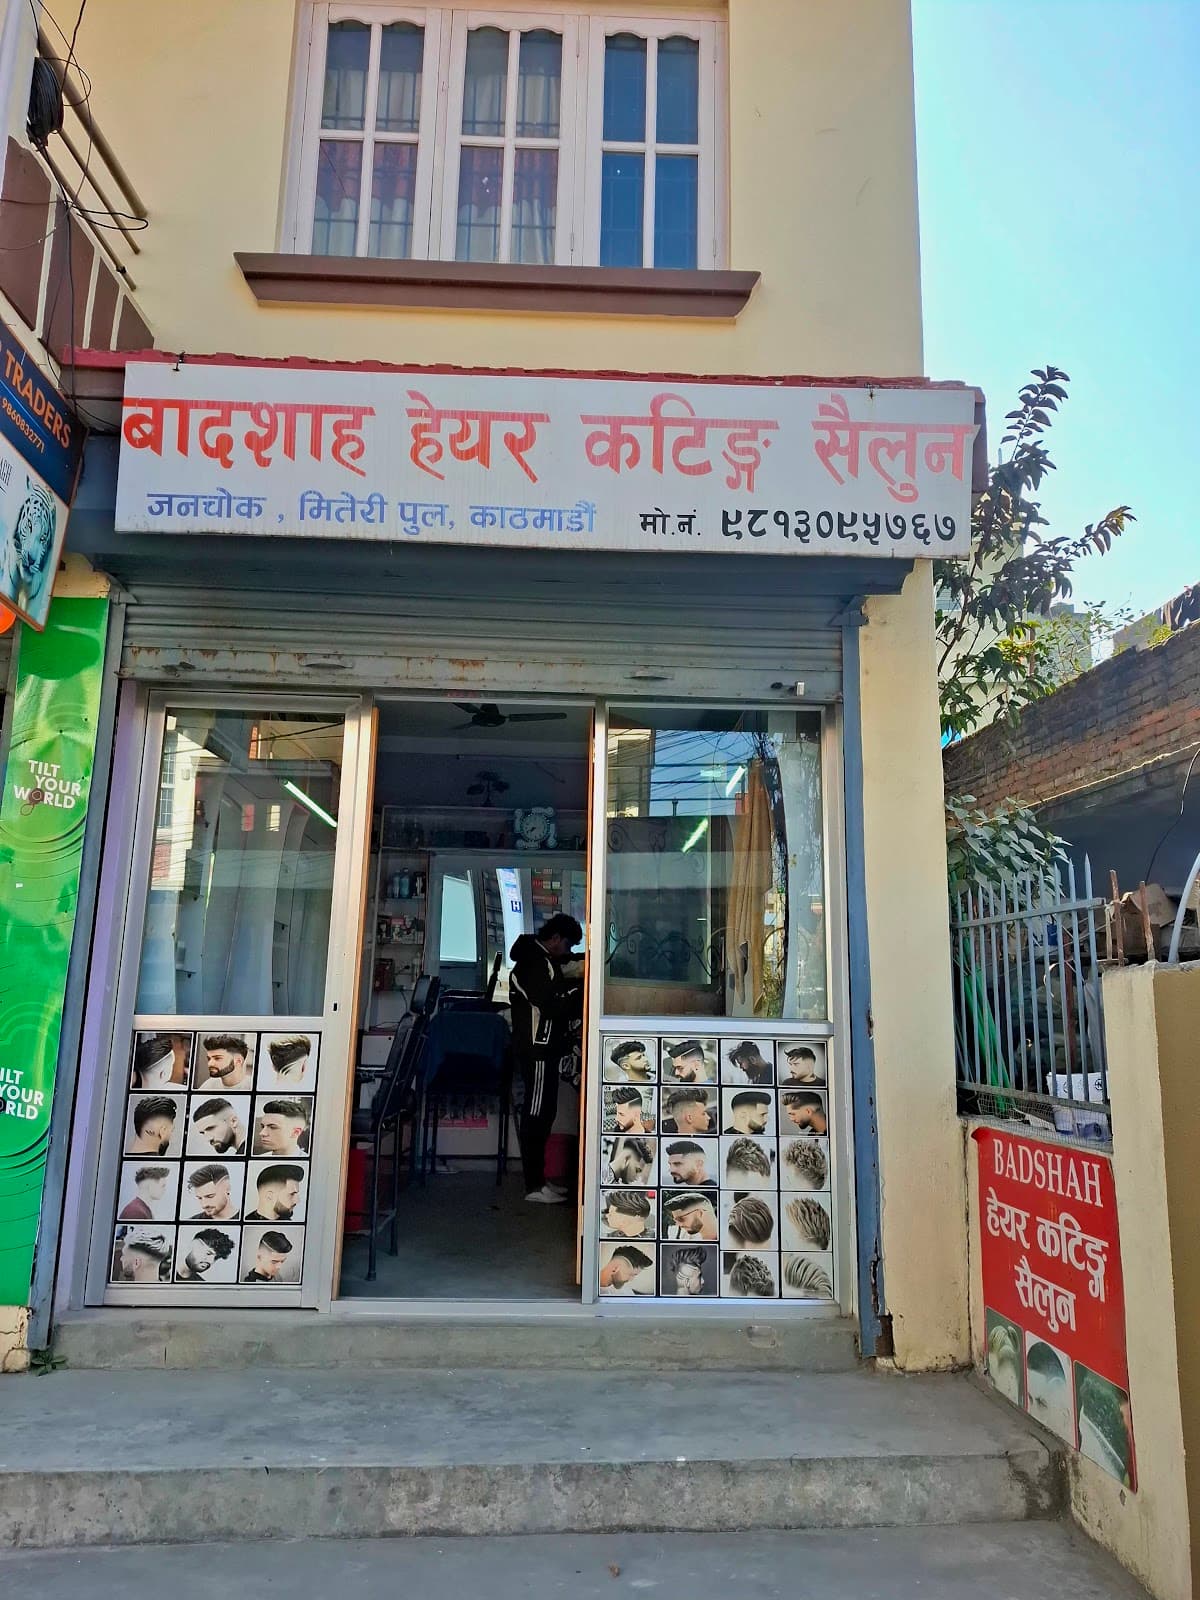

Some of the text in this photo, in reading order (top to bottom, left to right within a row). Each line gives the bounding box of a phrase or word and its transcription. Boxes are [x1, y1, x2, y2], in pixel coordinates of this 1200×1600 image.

[2, 397, 45, 453] 9860832771
[5, 348, 71, 449] TRADERS
[123, 397, 376, 477] बादशाह
[405, 389, 550, 484] हेयर
[811, 392, 981, 504] सैलुन
[299, 489, 388, 524] मितेरी
[721, 509, 956, 546] ९८१३०९५७६७
[13, 784, 76, 809] WORLD
[28, 759, 61, 778] TILT
[35, 775, 82, 797] YOUR
[993, 1138, 1103, 1208] BADSHAH
[986, 1186, 1031, 1250] हेयर
[1014, 1255, 1077, 1333] सैलुन
